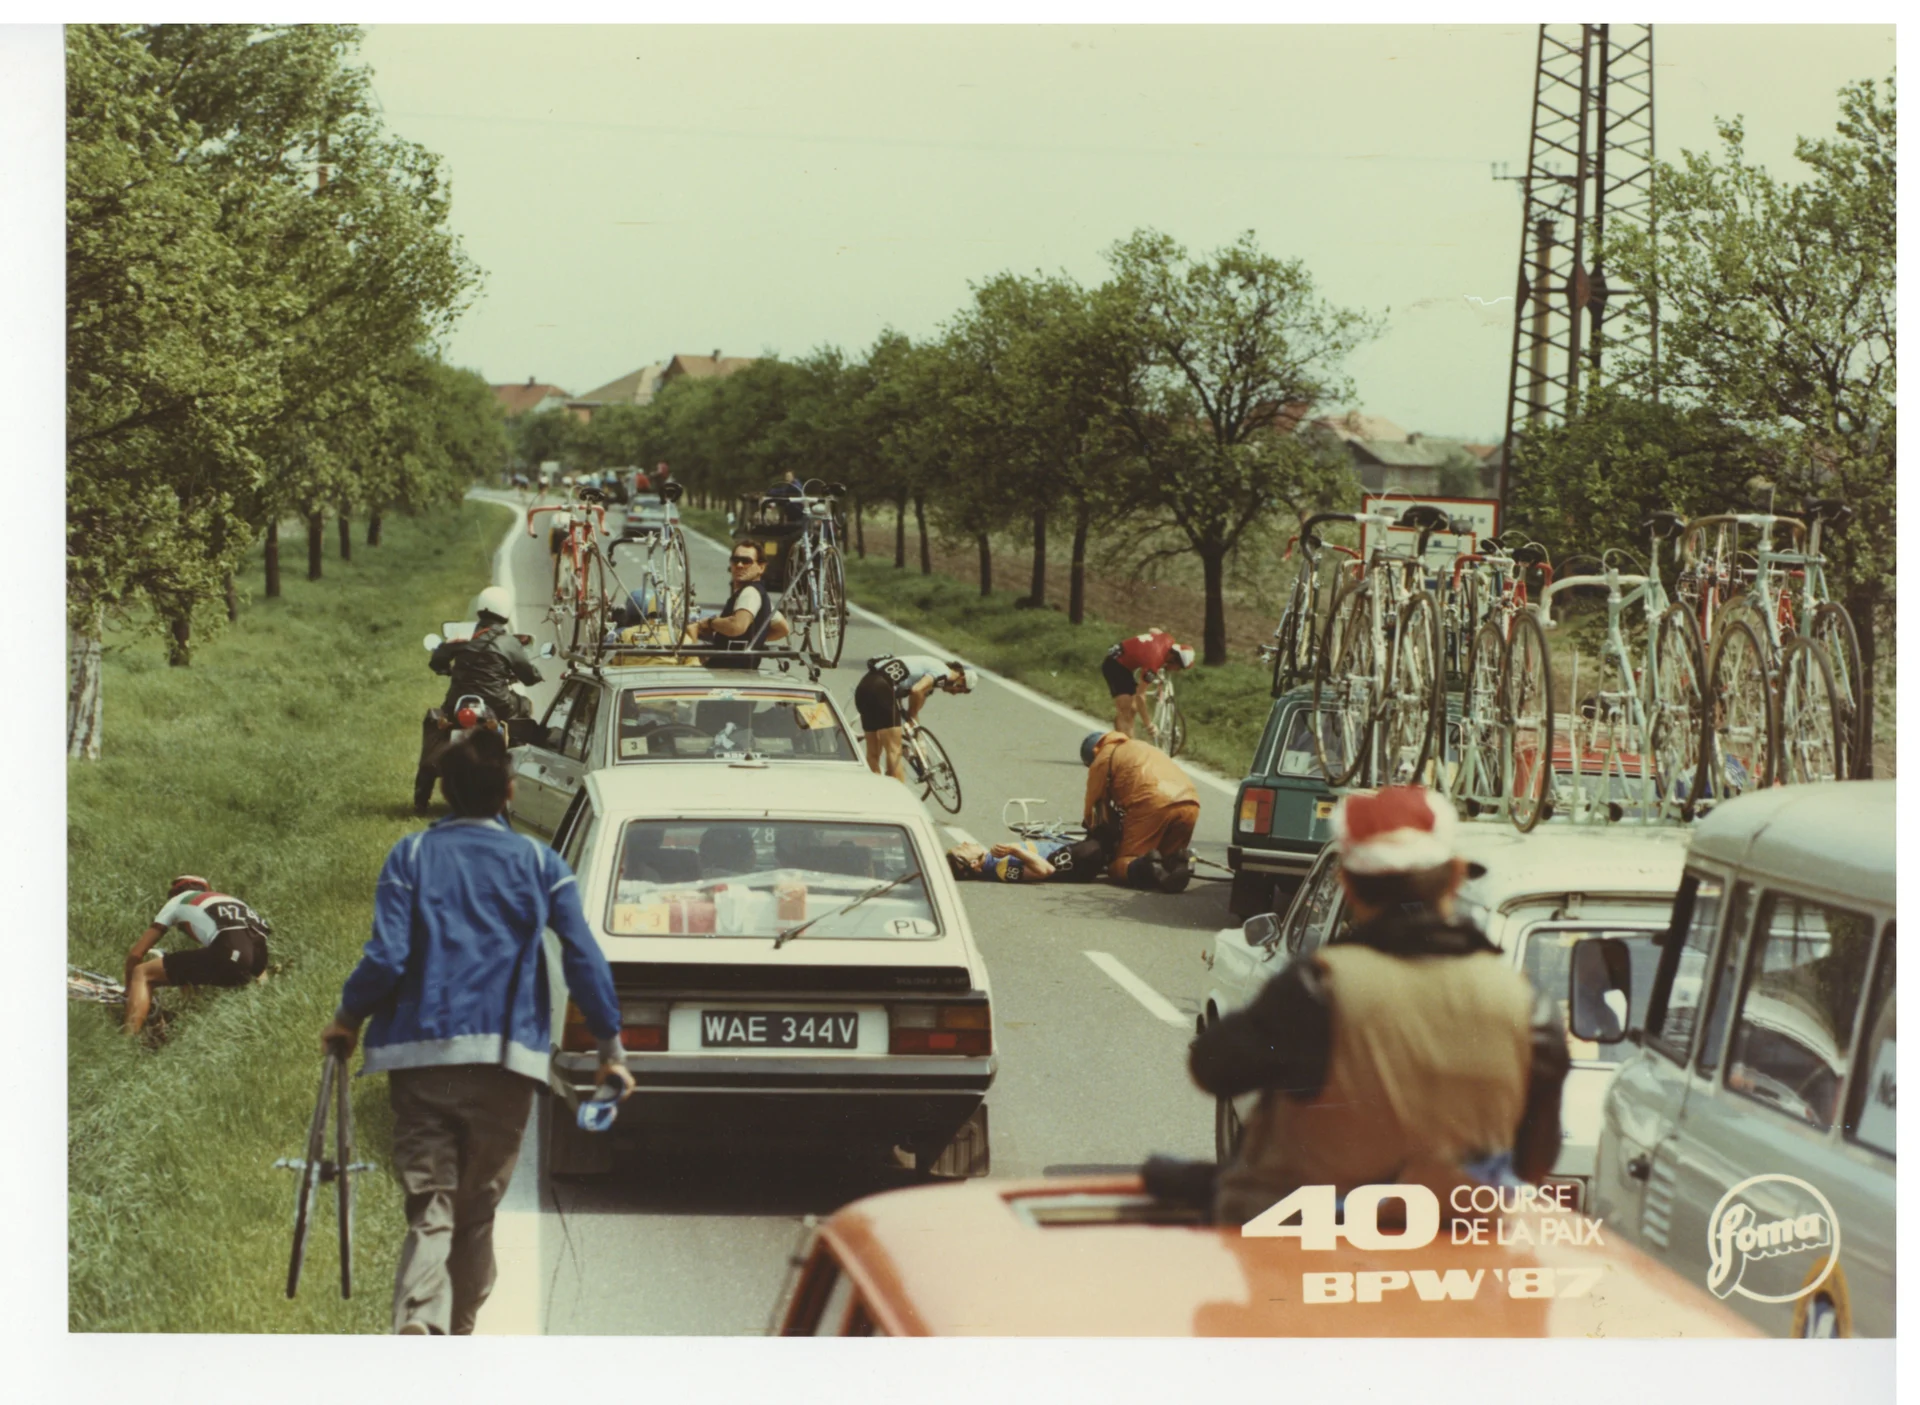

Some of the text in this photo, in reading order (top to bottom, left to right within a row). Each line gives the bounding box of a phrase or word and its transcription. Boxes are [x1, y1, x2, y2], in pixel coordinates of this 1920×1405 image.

[885, 662, 905, 681] 88
[631, 741, 637, 751] 3
[218, 905, 246, 920] 42
[894, 920, 926, 935] PL
[705, 1016, 855, 1043] WAE 344V
